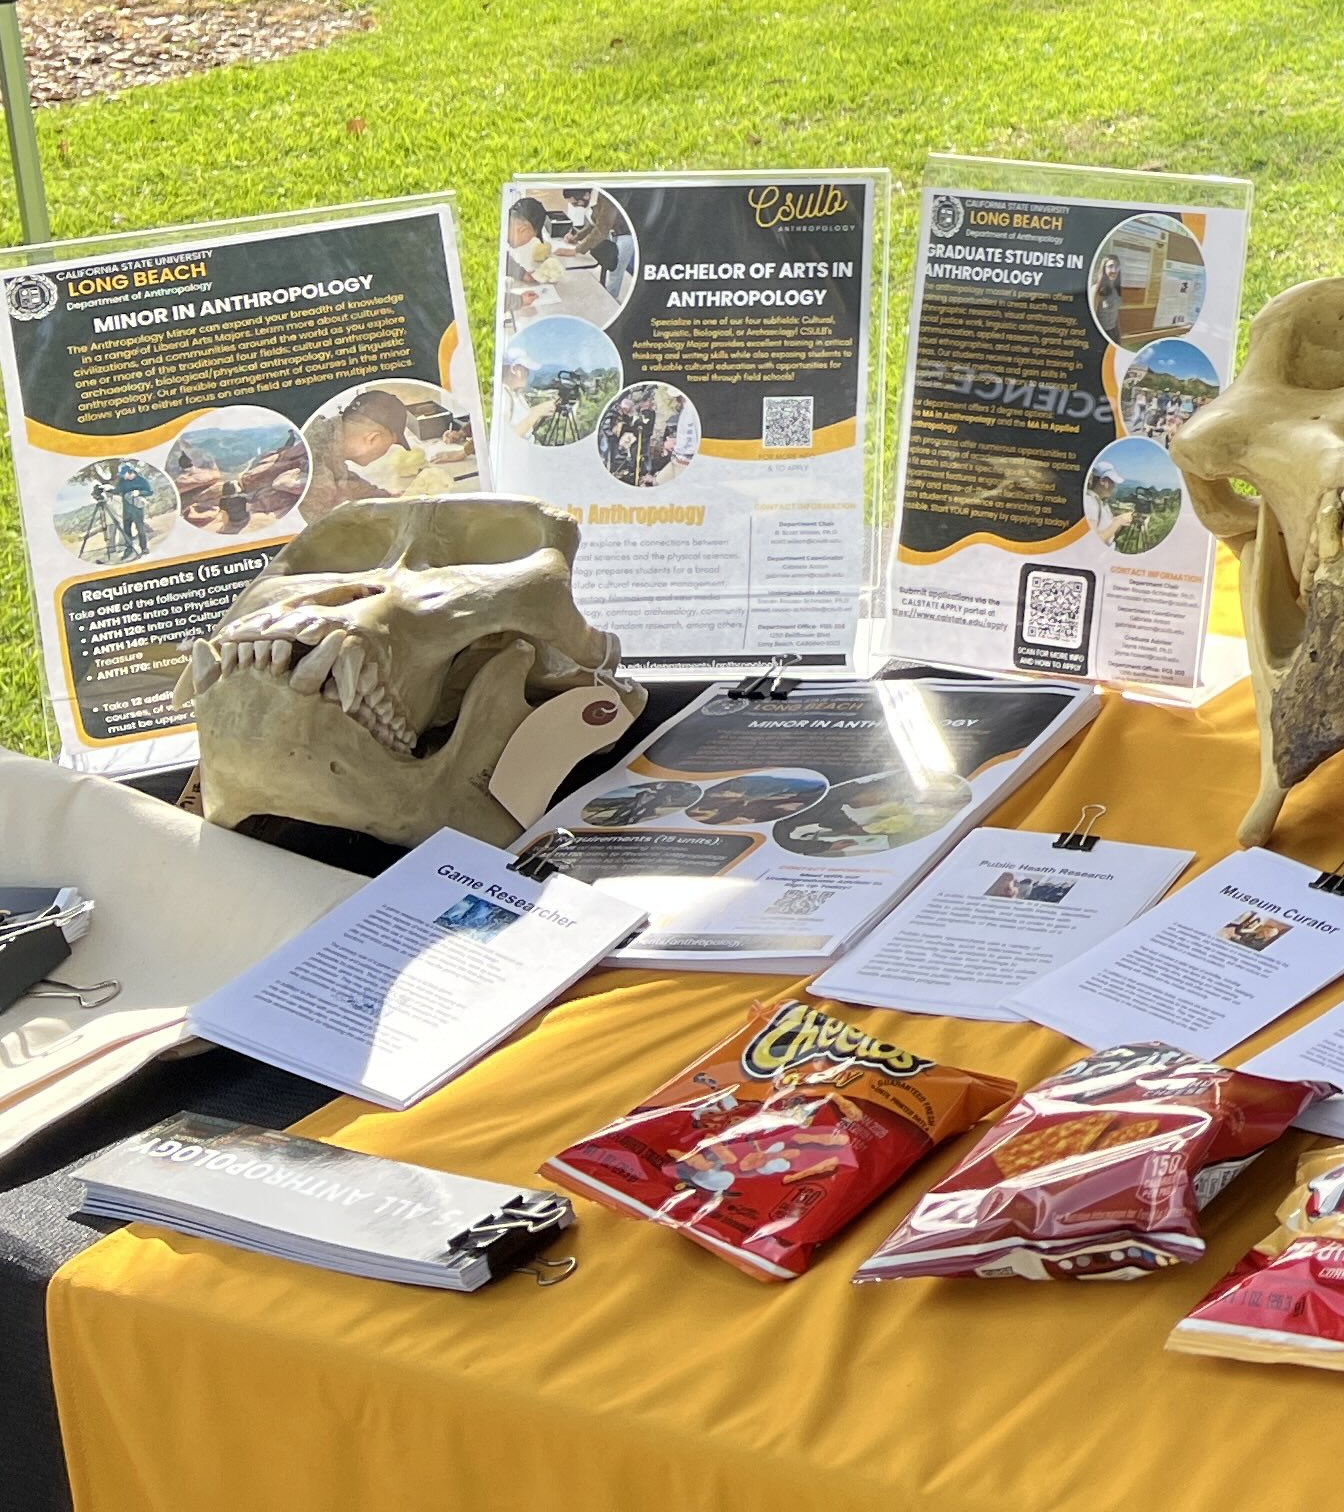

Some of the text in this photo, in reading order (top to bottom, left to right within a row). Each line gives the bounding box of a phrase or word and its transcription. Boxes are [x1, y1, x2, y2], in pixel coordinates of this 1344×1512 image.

[778, 224, 856, 233] ANTHROPOLOGY
[969, 210, 1062, 230] LONG BEACH
[55, 249, 213, 281] CALIFORNIA STATE UNIVERSITY
[927, 241, 1083, 269] GRADUATE STUDIES IN
[67, 261, 206, 296] LONG BEACH
[643, 261, 852, 280] BACHELOR OF ARTS IN
[924, 261, 1043, 285] ANTHROPOLOGY
[66, 281, 212, 310] Department of Anthropology
[93, 274, 373, 333] MINOR IN ANTHROPOLOGY
[666, 289, 827, 307] ANTHROPOLOGY
[66, 293, 403, 354] The Anthropology Minor can expand your breadth of knowledge
[588, 504, 706, 526] Anthropology
[81, 571, 194, 602] Requirements
[197, 564, 220, 581] (15
[68, 579, 250, 621] Take ONE of the following courses
[88, 594, 229, 630] ANTH 110: Intro to Physical
[90, 609, 227, 643] ANTH 120: Intro to Cultur
[92, 626, 204, 655] ANTH 140: Pyramids,
[94, 651, 143, 667] Treasure
[978, 859, 1114, 880] Public Health Research
[437, 863, 577, 930] Game Researcher
[1219, 884, 1340, 934] Museum Curator
[742, 1001, 930, 1076] Cheetos
[132, 1137, 371, 1207] ANTHROPOLOGY
[1152, 1155, 1182, 1178] 150
